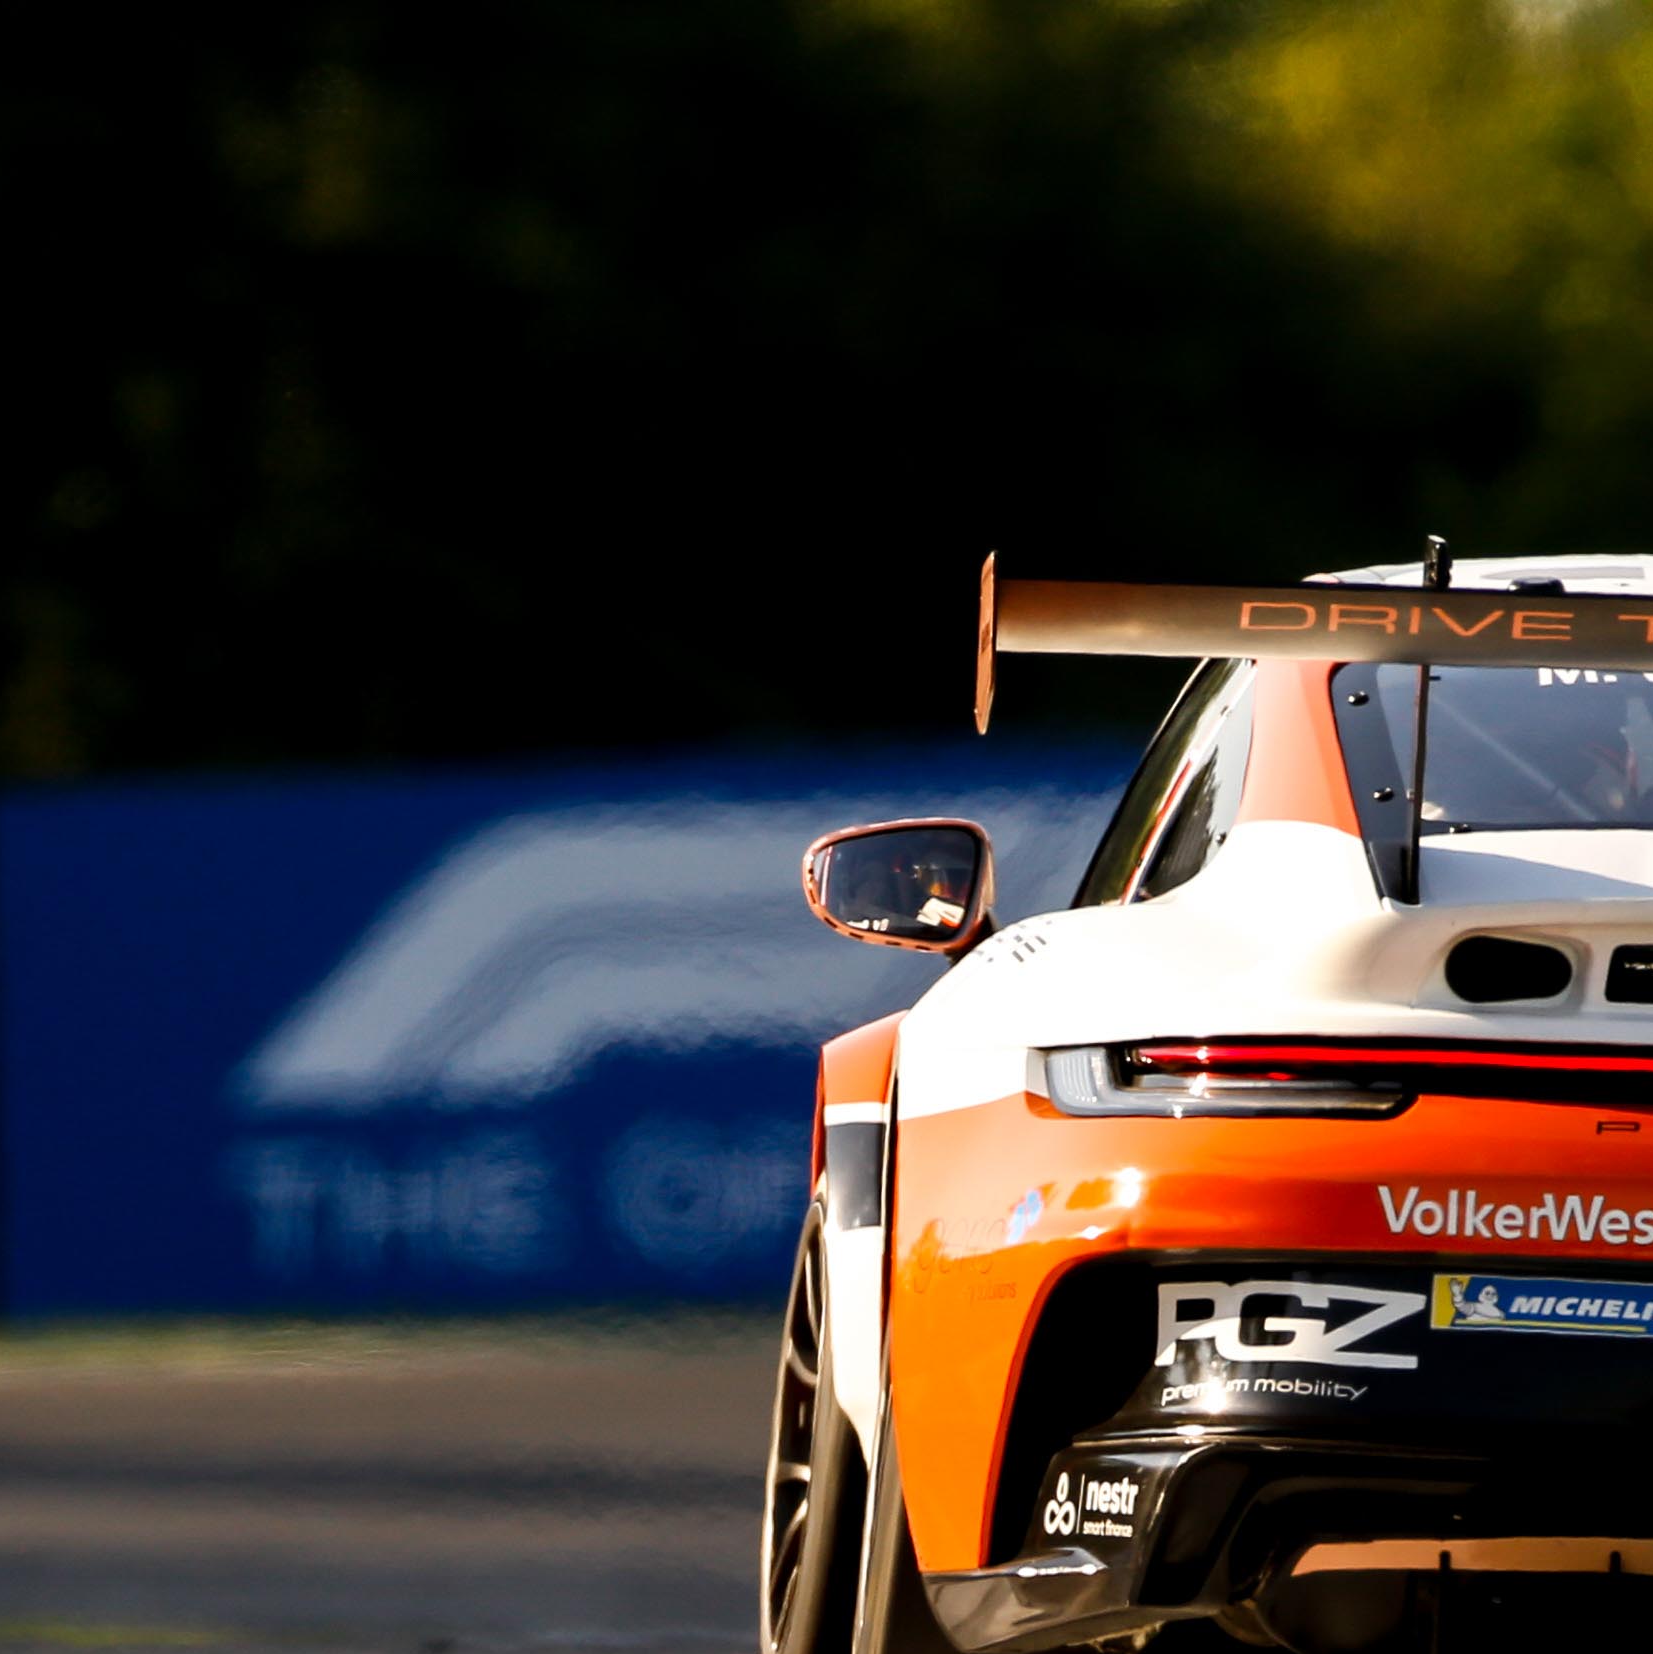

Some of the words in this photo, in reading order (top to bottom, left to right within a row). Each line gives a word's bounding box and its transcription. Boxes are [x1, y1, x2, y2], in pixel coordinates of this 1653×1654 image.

[1239, 601, 1575, 641] DRIVE
[1154, 1280, 1427, 1370] PGZ
[1253, 1377, 1370, 1401] mobility
[1085, 1476, 1139, 1515] nestr
